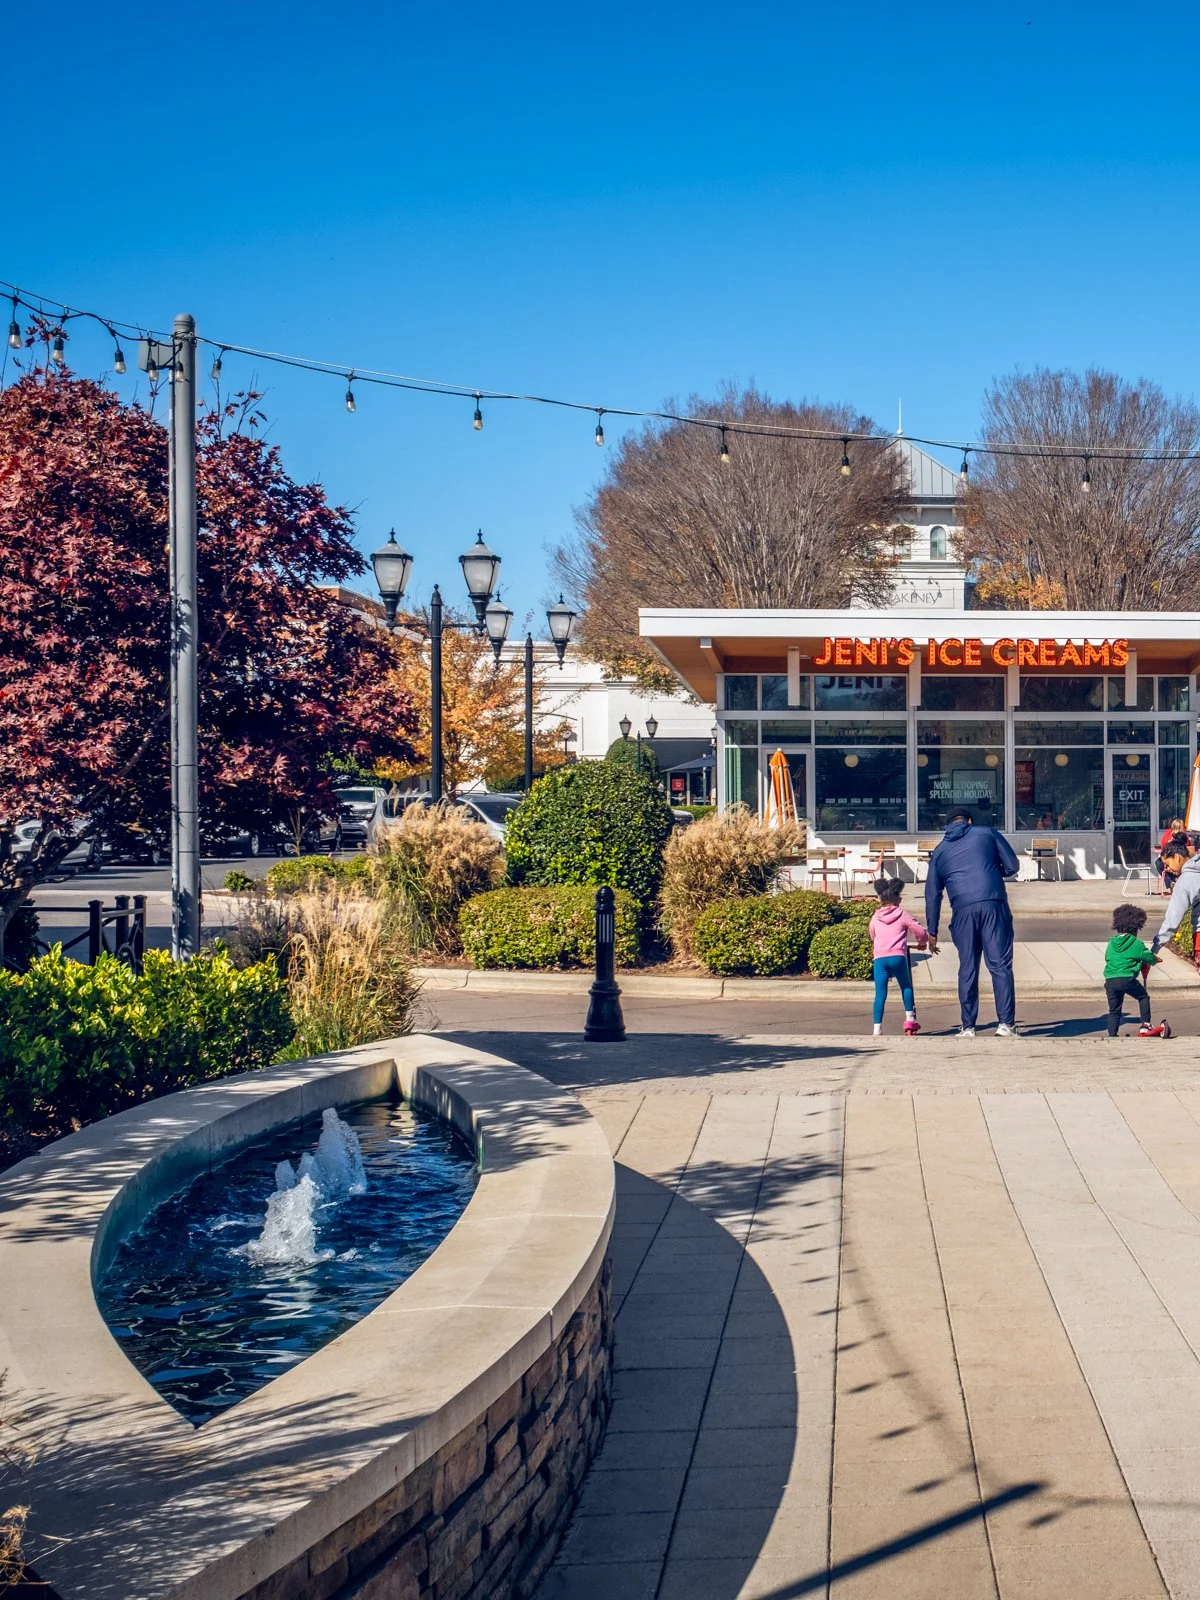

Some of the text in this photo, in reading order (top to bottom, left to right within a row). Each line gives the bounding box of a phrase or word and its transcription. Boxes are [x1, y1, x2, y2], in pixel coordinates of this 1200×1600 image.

[814, 637, 1129, 666] JENI'S ICE CREAMS
[933, 780, 989, 790] NOW SCOOPING
[929, 789, 993, 799] SPLENDID HOLIDAY
[1119, 790, 1144, 801] EXIT
